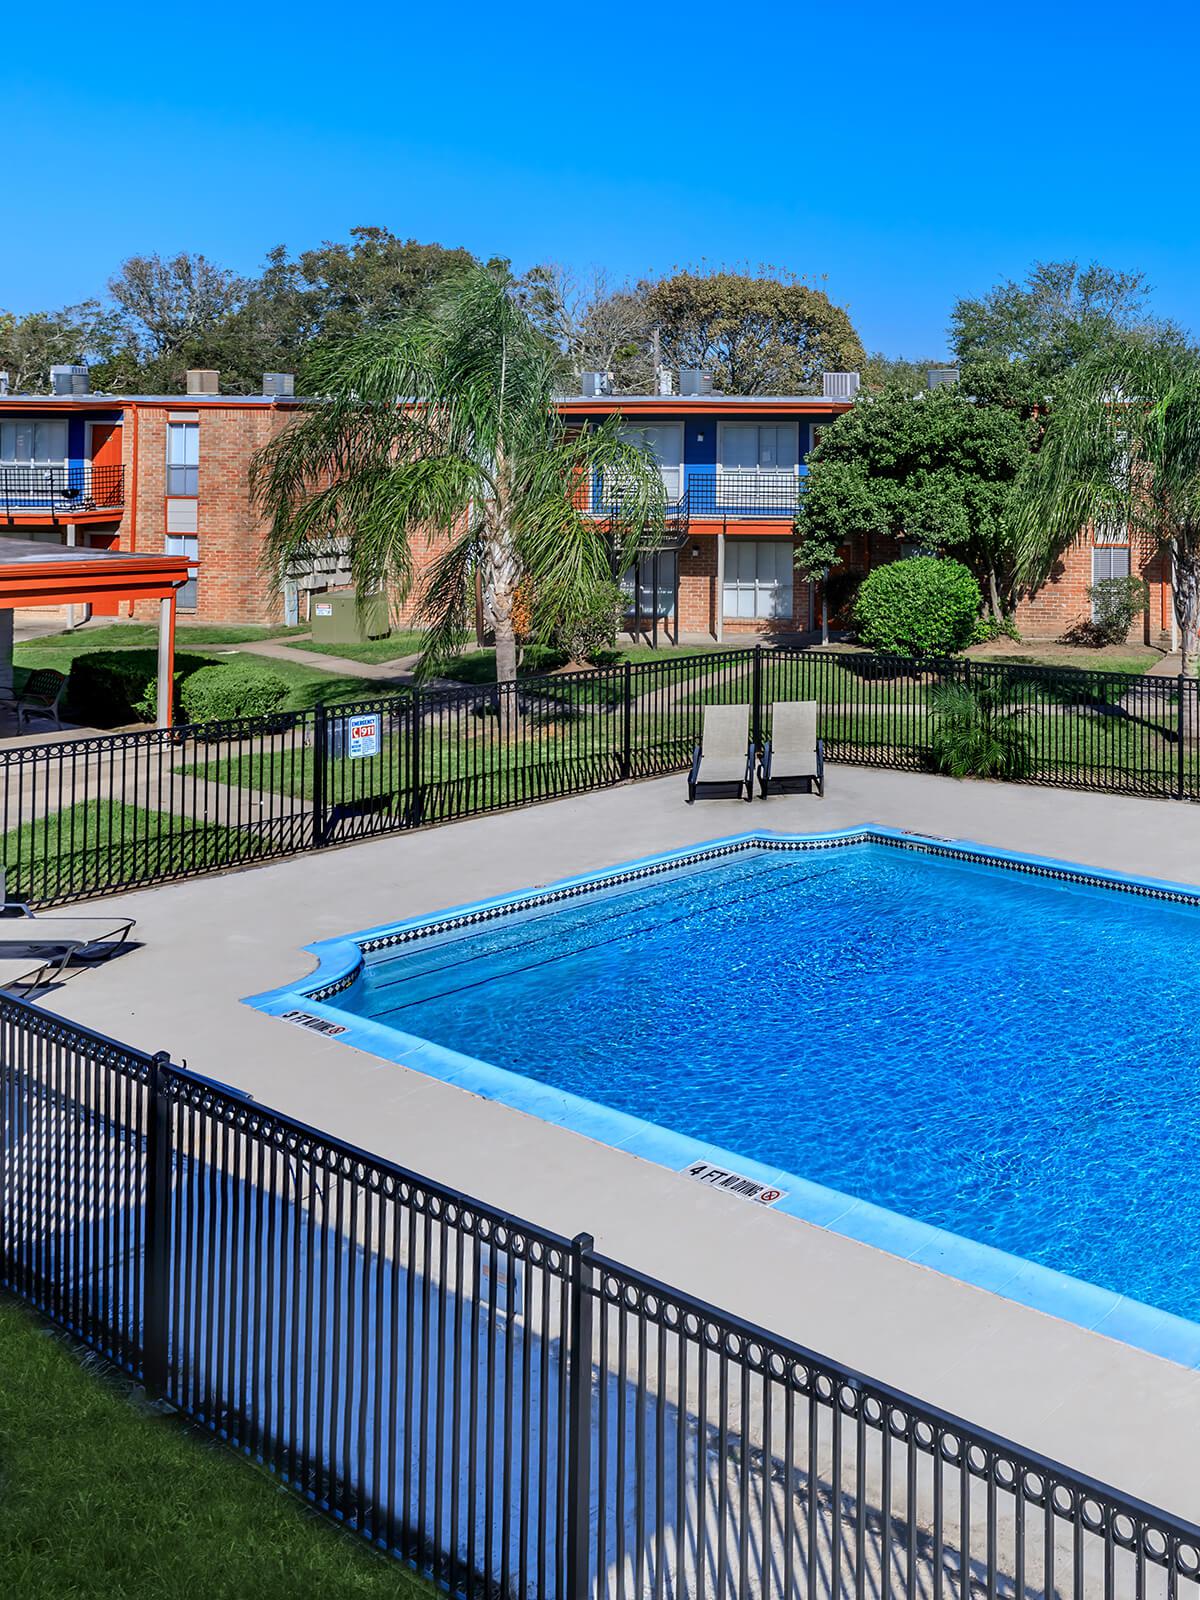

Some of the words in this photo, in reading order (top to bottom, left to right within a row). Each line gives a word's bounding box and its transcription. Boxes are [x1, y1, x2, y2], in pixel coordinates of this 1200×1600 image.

[361, 726, 375, 736] 911
[289, 1014, 314, 1023] FT
[689, 1165, 708, 1176] 4
[700, 1169, 729, 1183] FT
[719, 1175, 741, 1188] NO
[730, 1179, 765, 1197] DIVING
